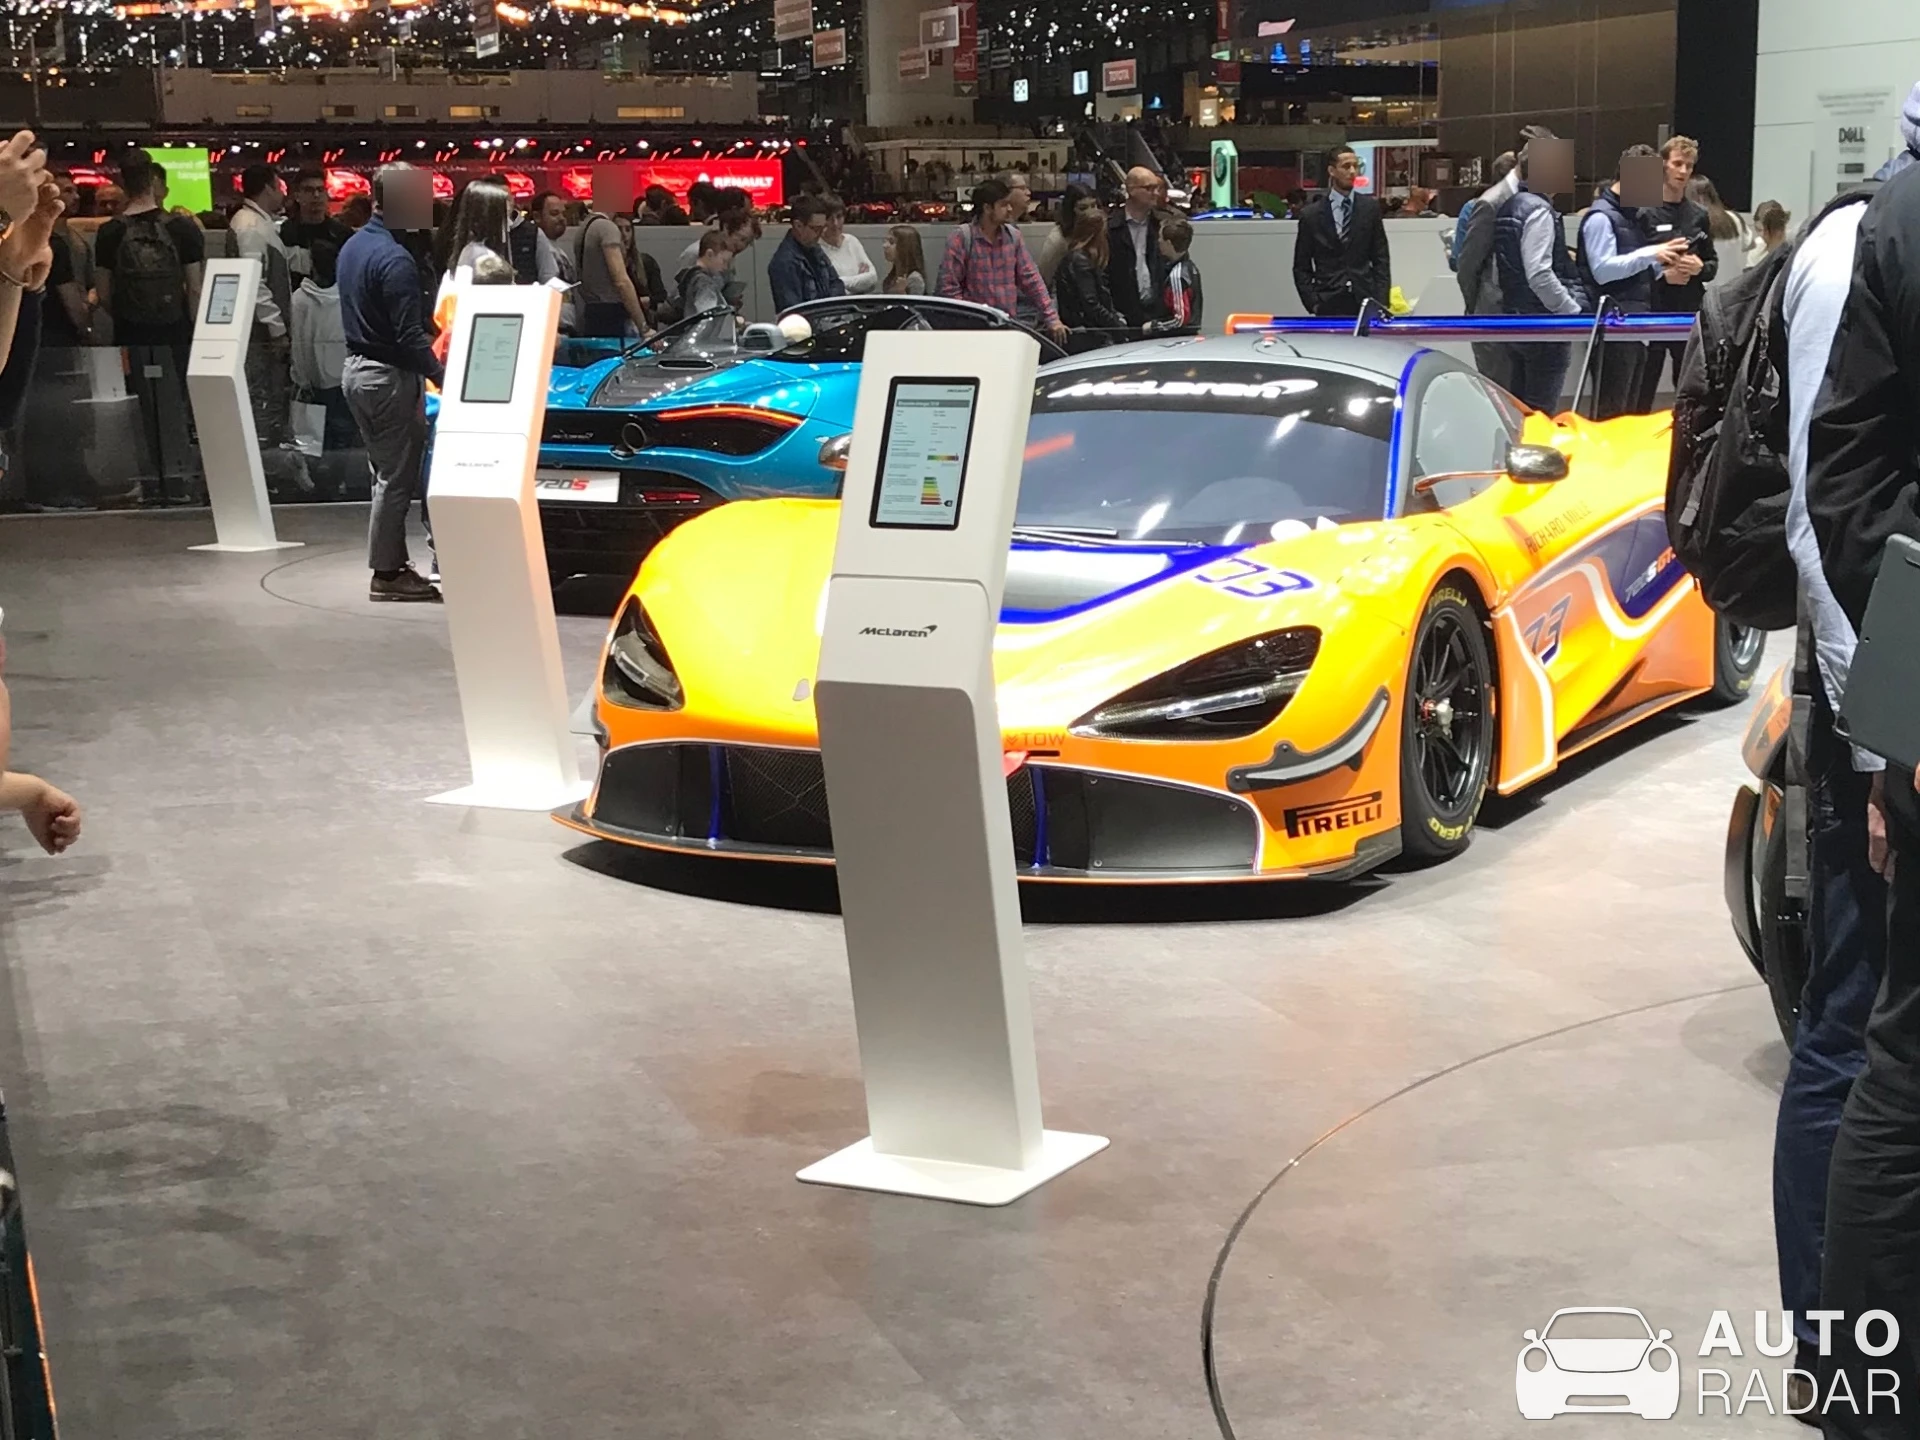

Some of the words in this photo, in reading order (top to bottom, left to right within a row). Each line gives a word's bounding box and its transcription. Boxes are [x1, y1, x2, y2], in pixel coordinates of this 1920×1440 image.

[1838, 126, 1866, 143] DELL
[713, 176, 775, 189] RENAULT
[1047, 379, 1285, 399] McLaren
[535, 478, 589, 491] 720S
[1524, 517, 1567, 556] RICHARD
[858, 626, 929, 638] McLaren
[1523, 592, 1574, 667] 73
[1020, 732, 1066, 747] TOW
[1283, 790, 1382, 839] PIRELLI
